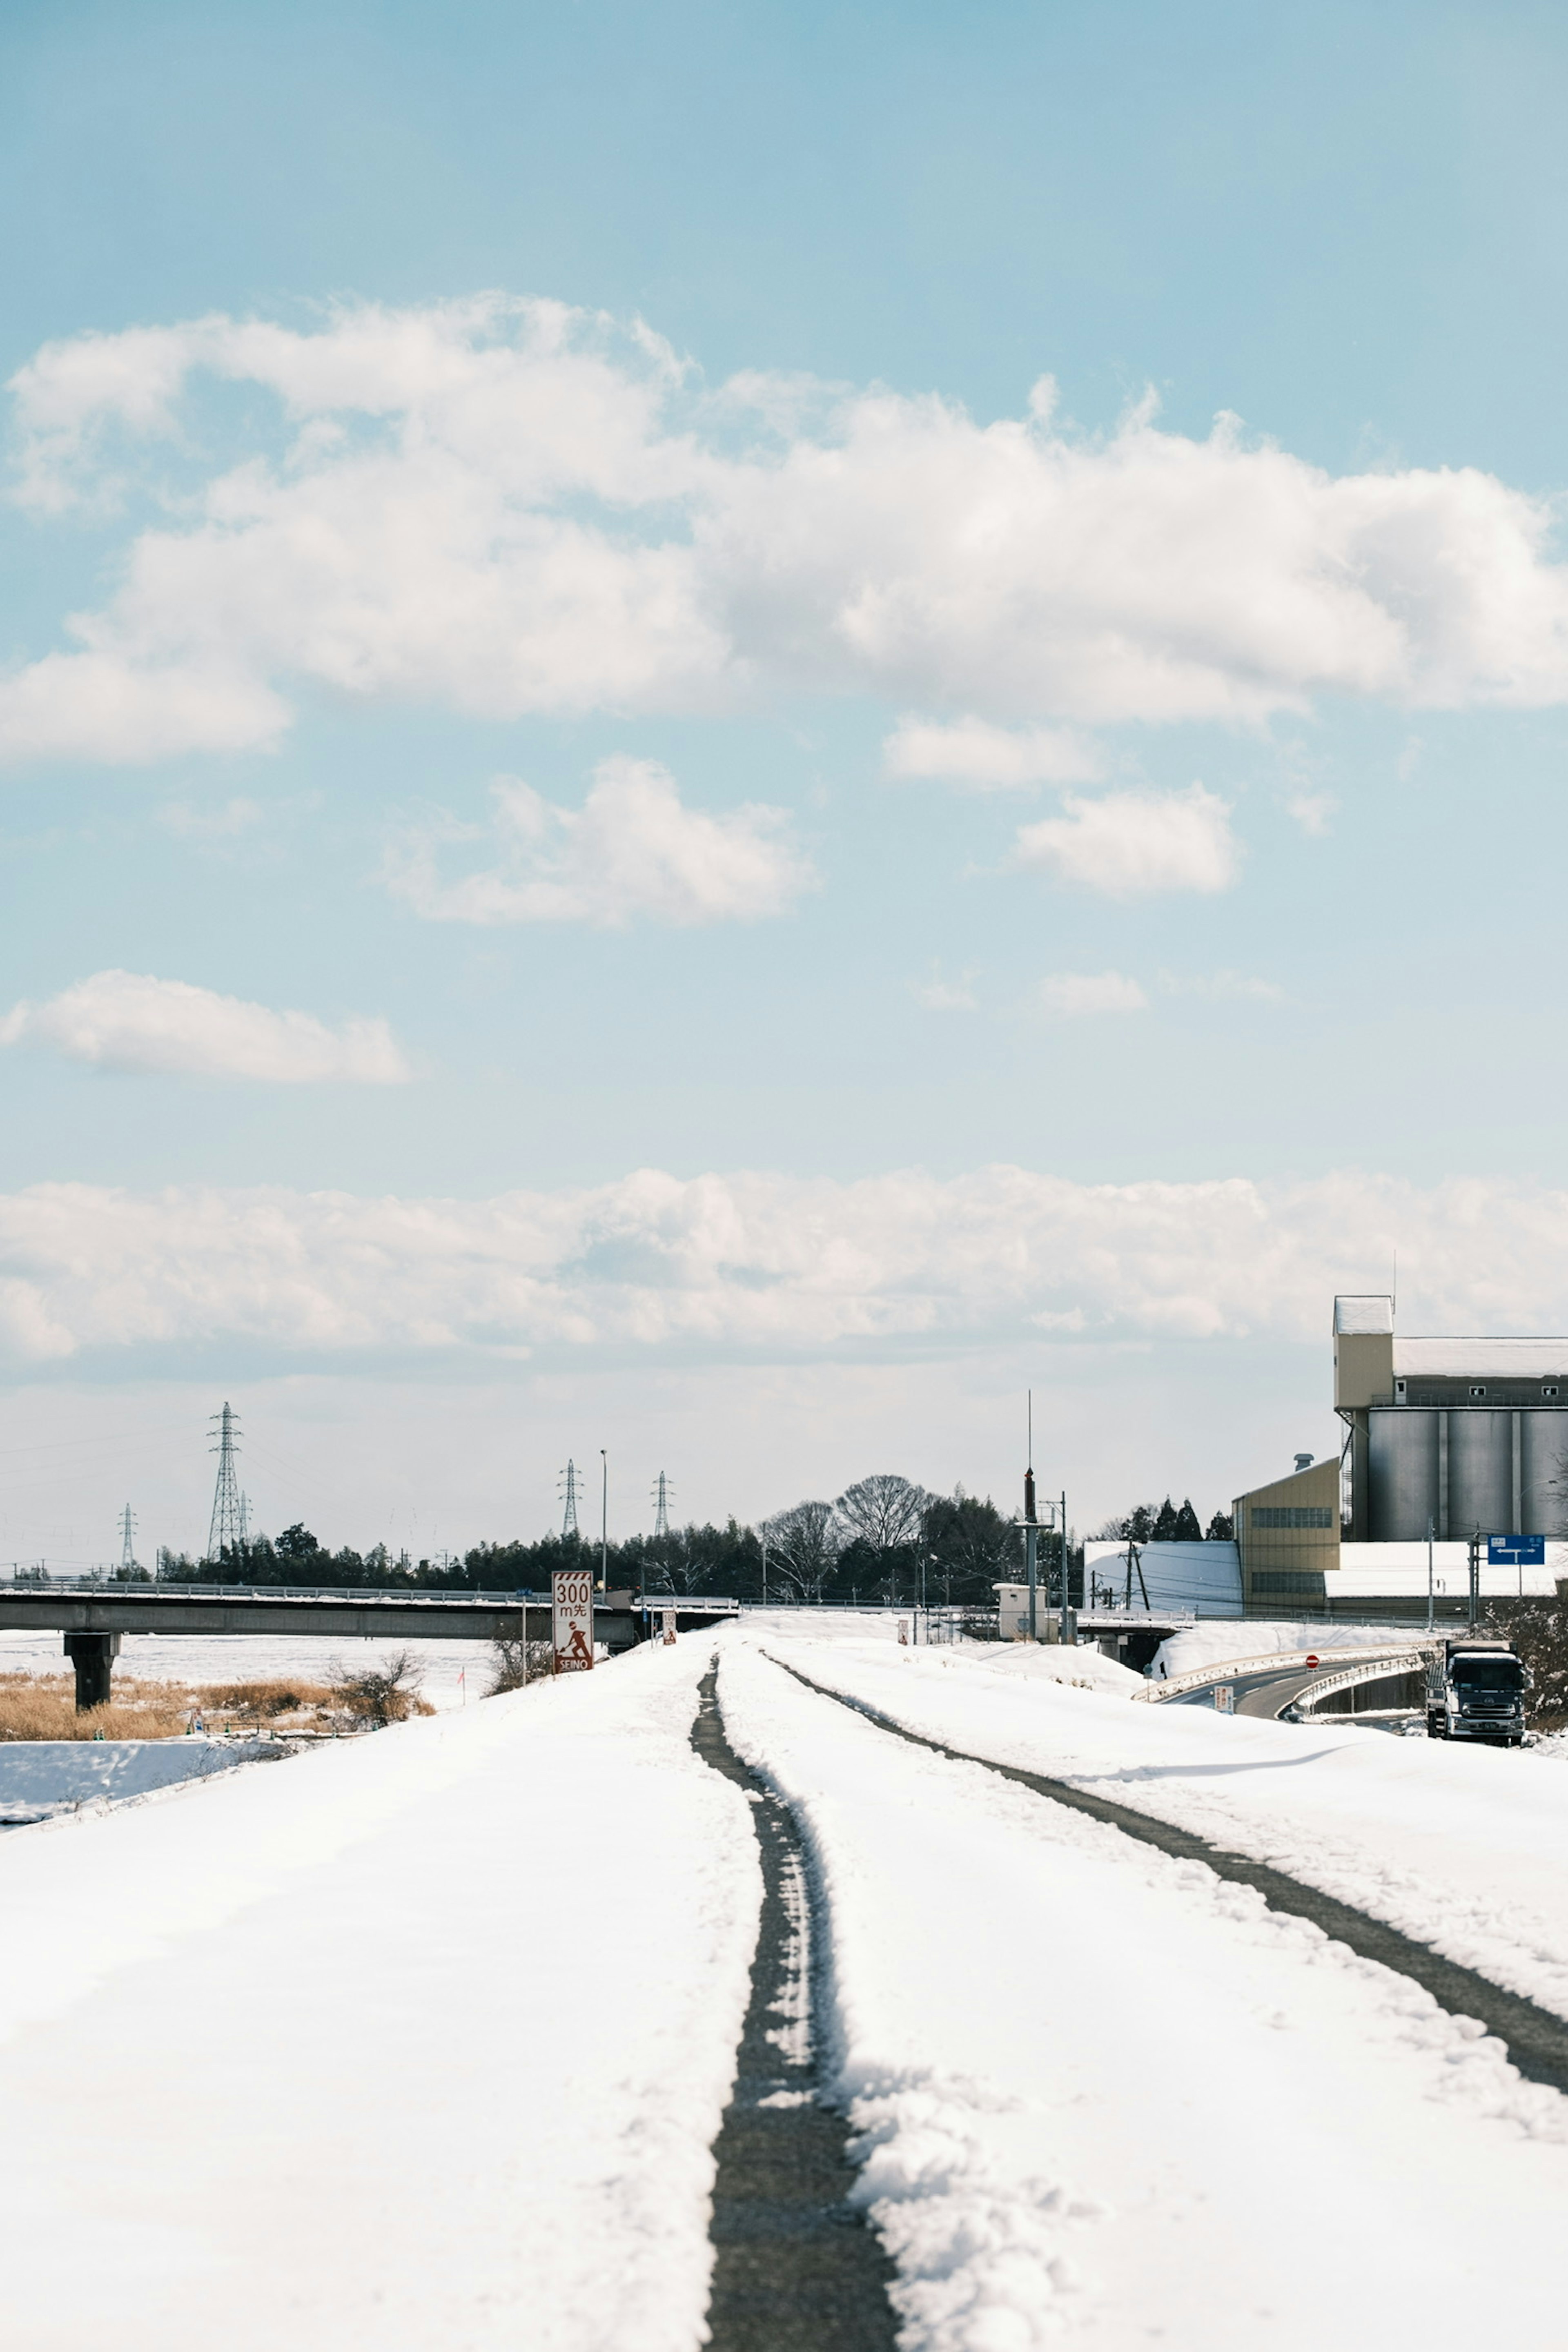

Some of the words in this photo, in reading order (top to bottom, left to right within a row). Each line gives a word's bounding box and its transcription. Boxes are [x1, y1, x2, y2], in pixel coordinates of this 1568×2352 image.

[557, 1583, 588, 1603] 300
[560, 1604, 586, 1617] m先
[560, 1659, 588, 1670] SEINO
